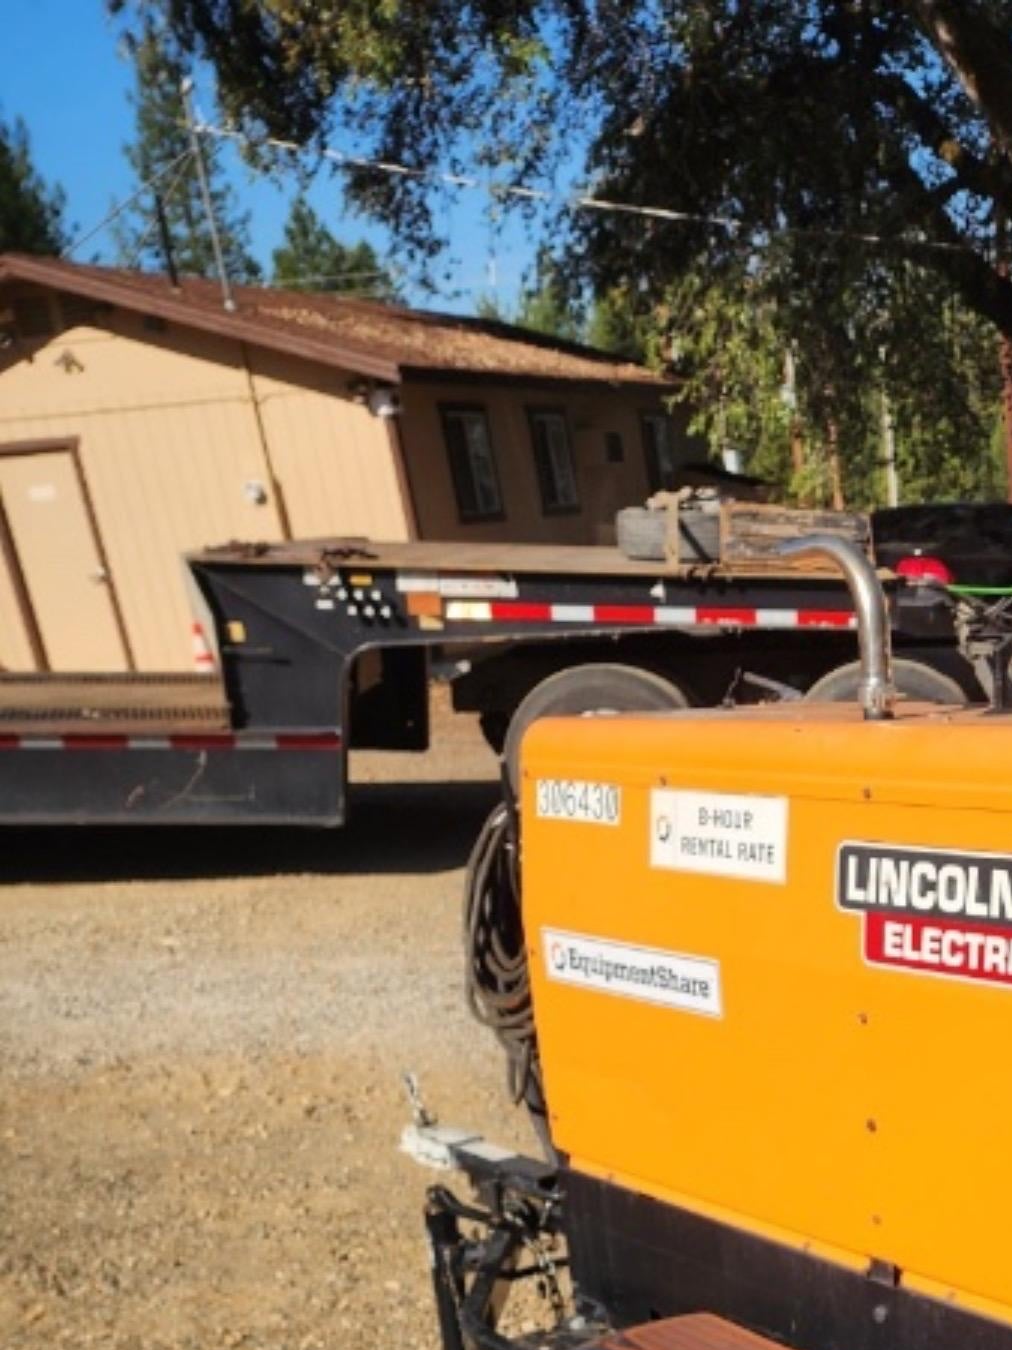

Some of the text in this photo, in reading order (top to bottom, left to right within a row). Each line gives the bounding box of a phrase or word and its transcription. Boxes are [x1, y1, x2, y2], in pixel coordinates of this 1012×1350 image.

[680, 836, 775, 864] RENTAL RATE
[566, 947, 710, 999] EquipmentShare
